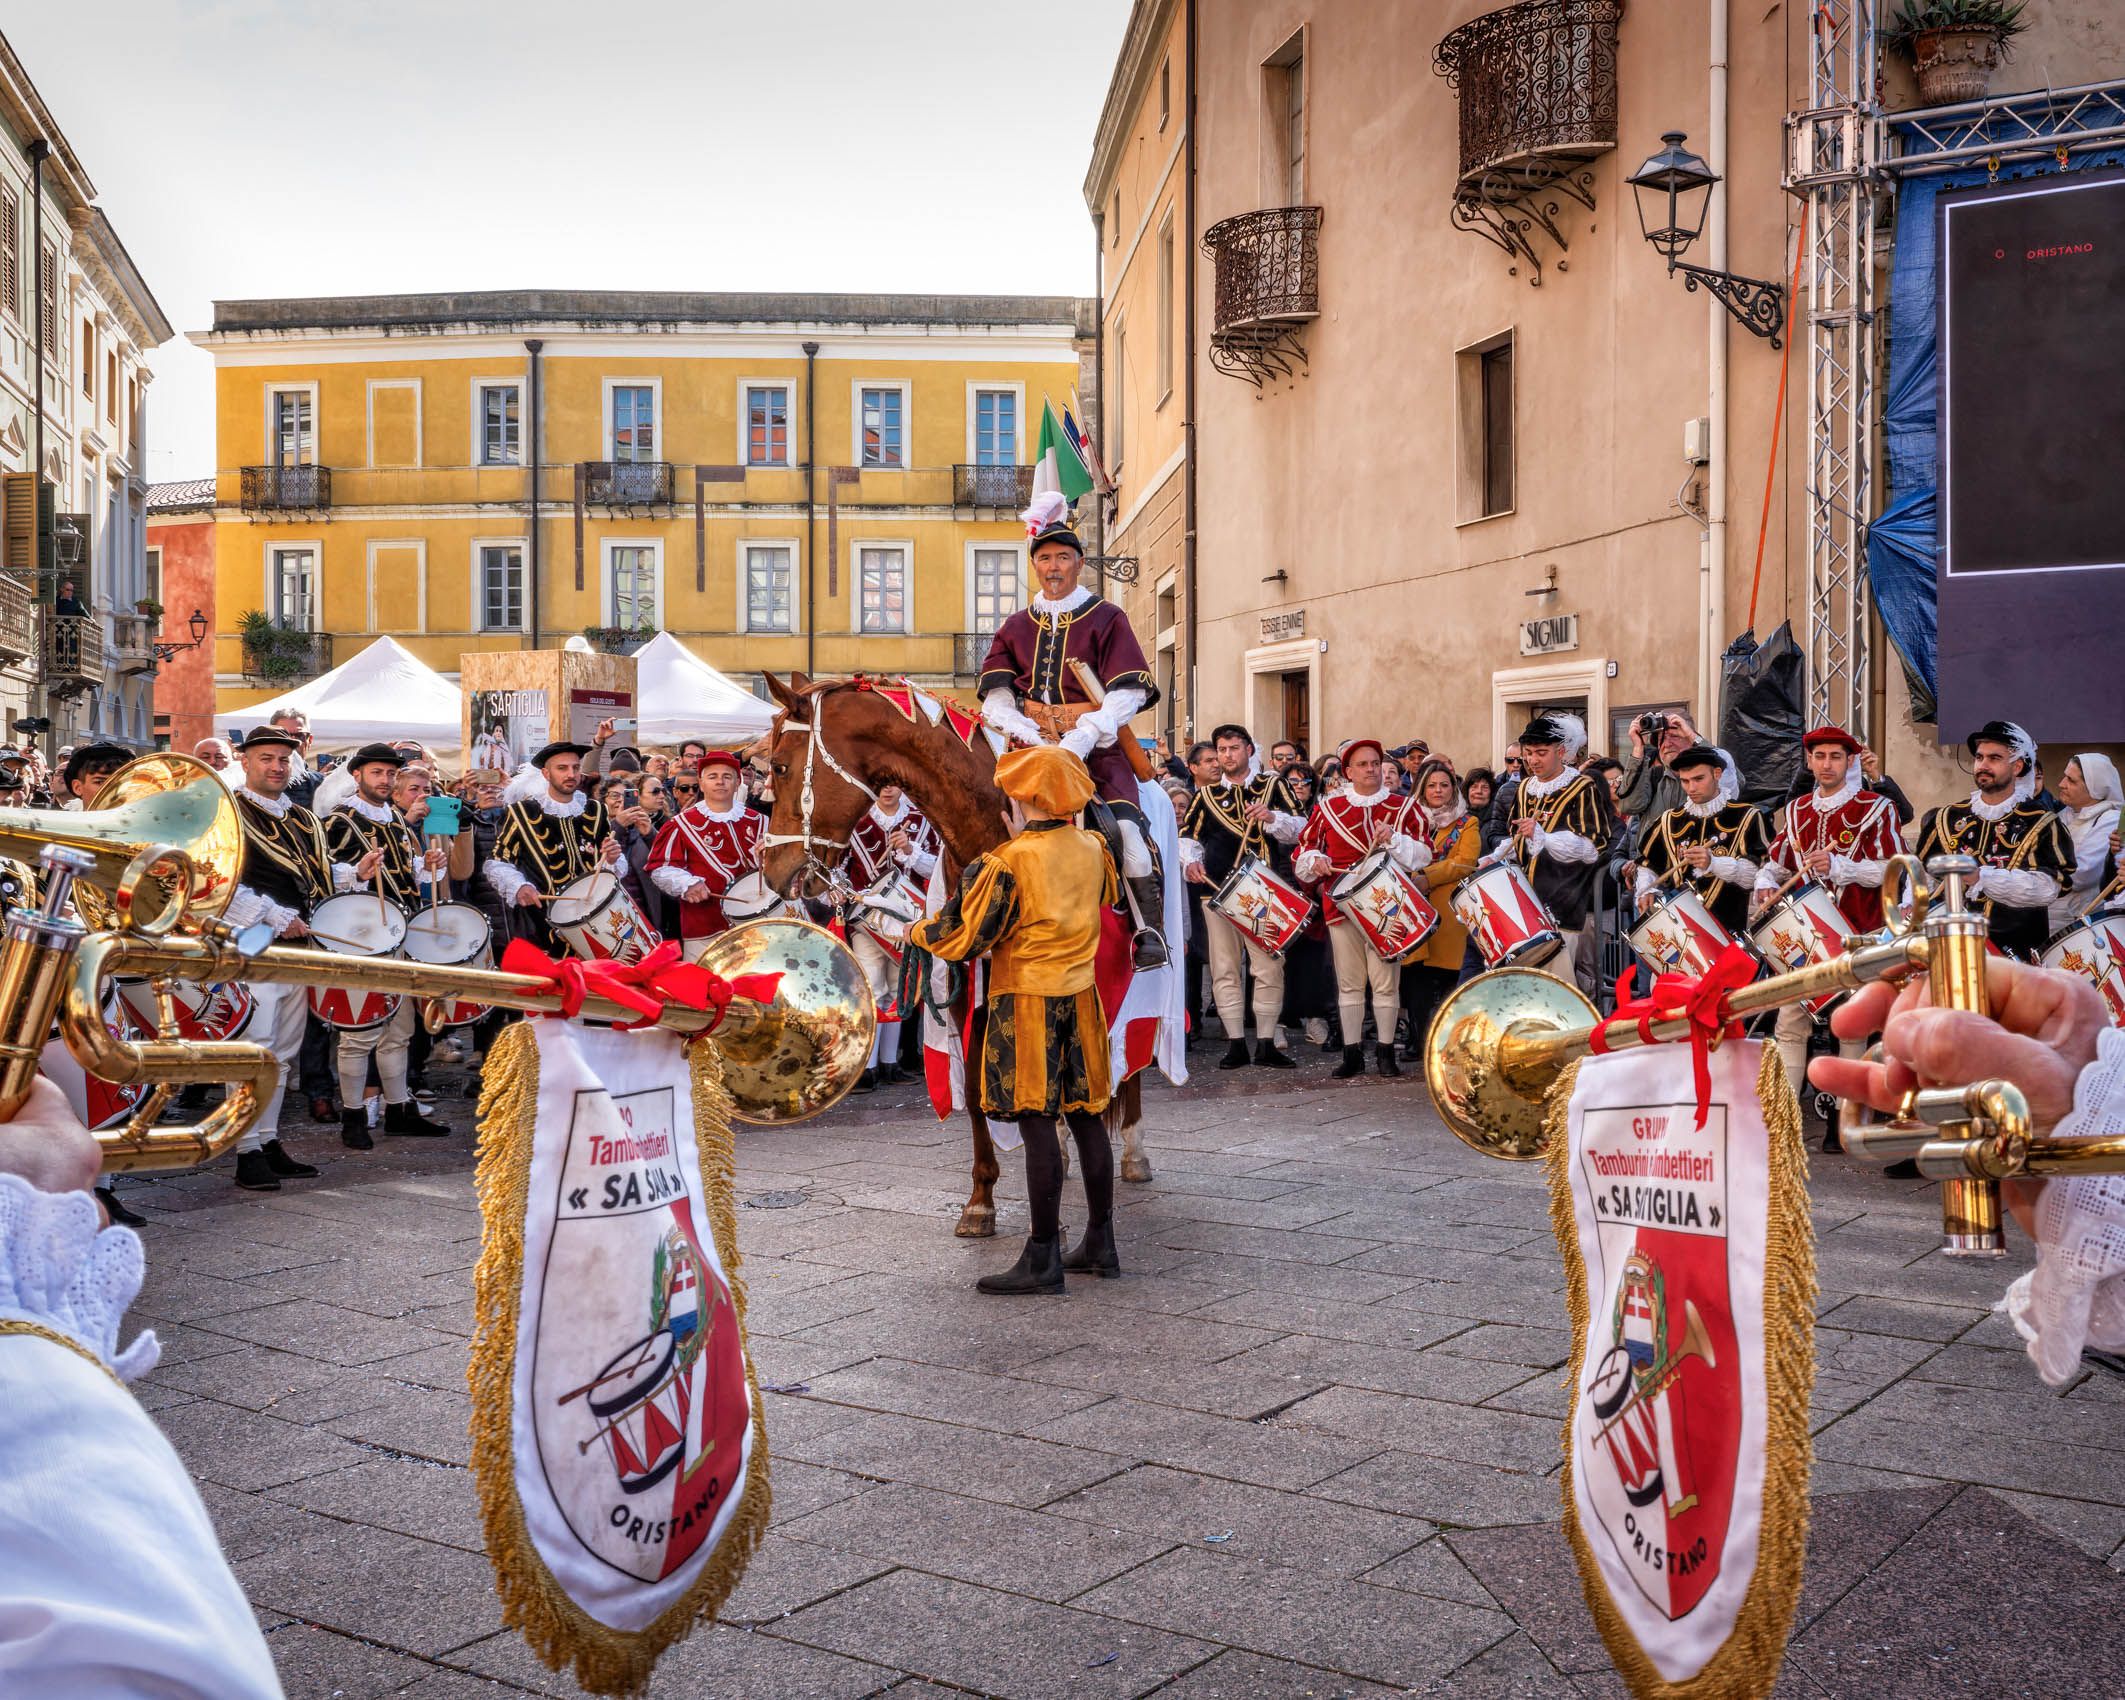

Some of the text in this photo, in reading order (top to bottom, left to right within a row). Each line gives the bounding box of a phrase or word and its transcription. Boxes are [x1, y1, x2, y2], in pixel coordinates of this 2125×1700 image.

[2026, 242, 2094, 260] ORISTANO
[490, 692, 546, 717] SARTIGLIA
[610, 1476, 720, 1544] ORISTANO
[1624, 1512, 1707, 1576] ORISTANO
